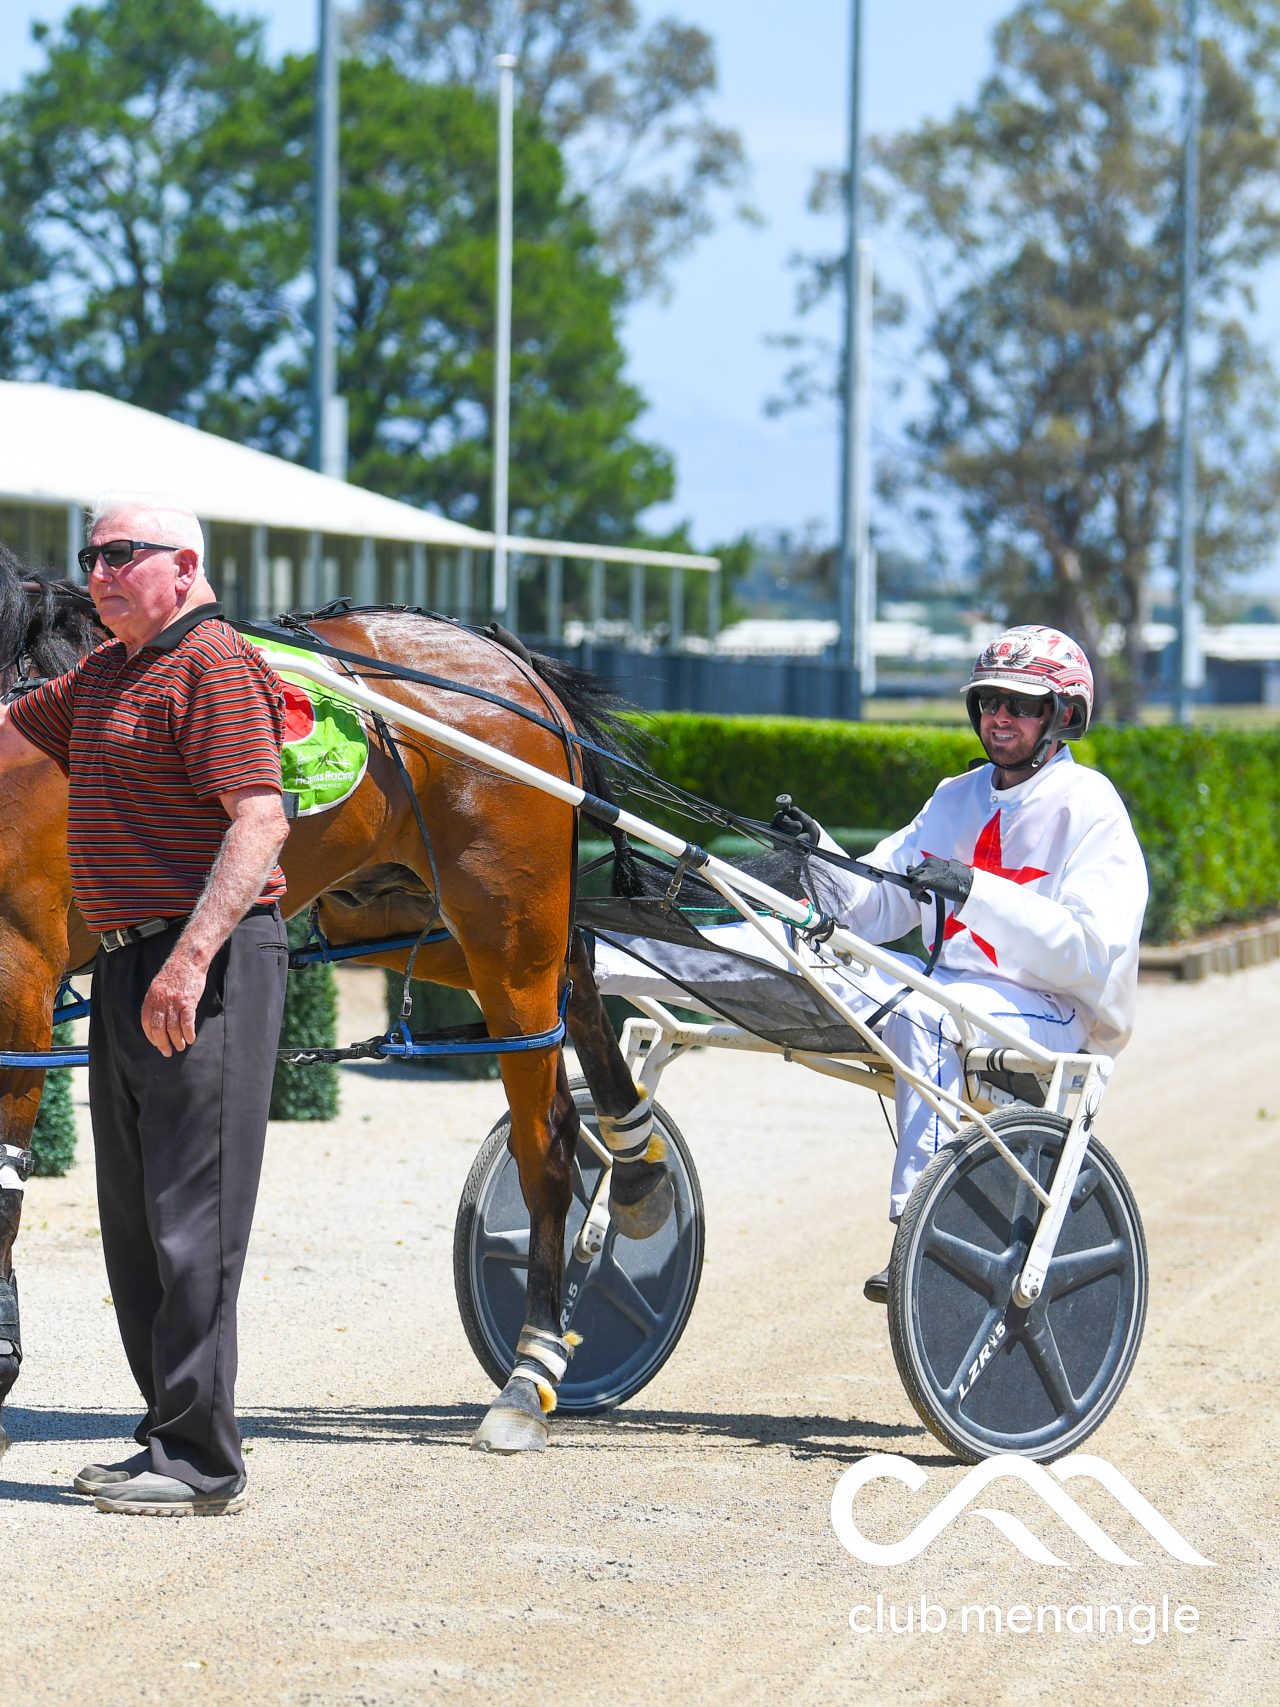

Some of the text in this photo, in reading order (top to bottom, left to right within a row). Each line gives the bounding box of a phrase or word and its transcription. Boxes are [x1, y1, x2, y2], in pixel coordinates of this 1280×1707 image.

[295, 774, 323, 785] Harss
[325, 771, 355, 782] Racing
[958, 1344, 992, 1401] LZR
